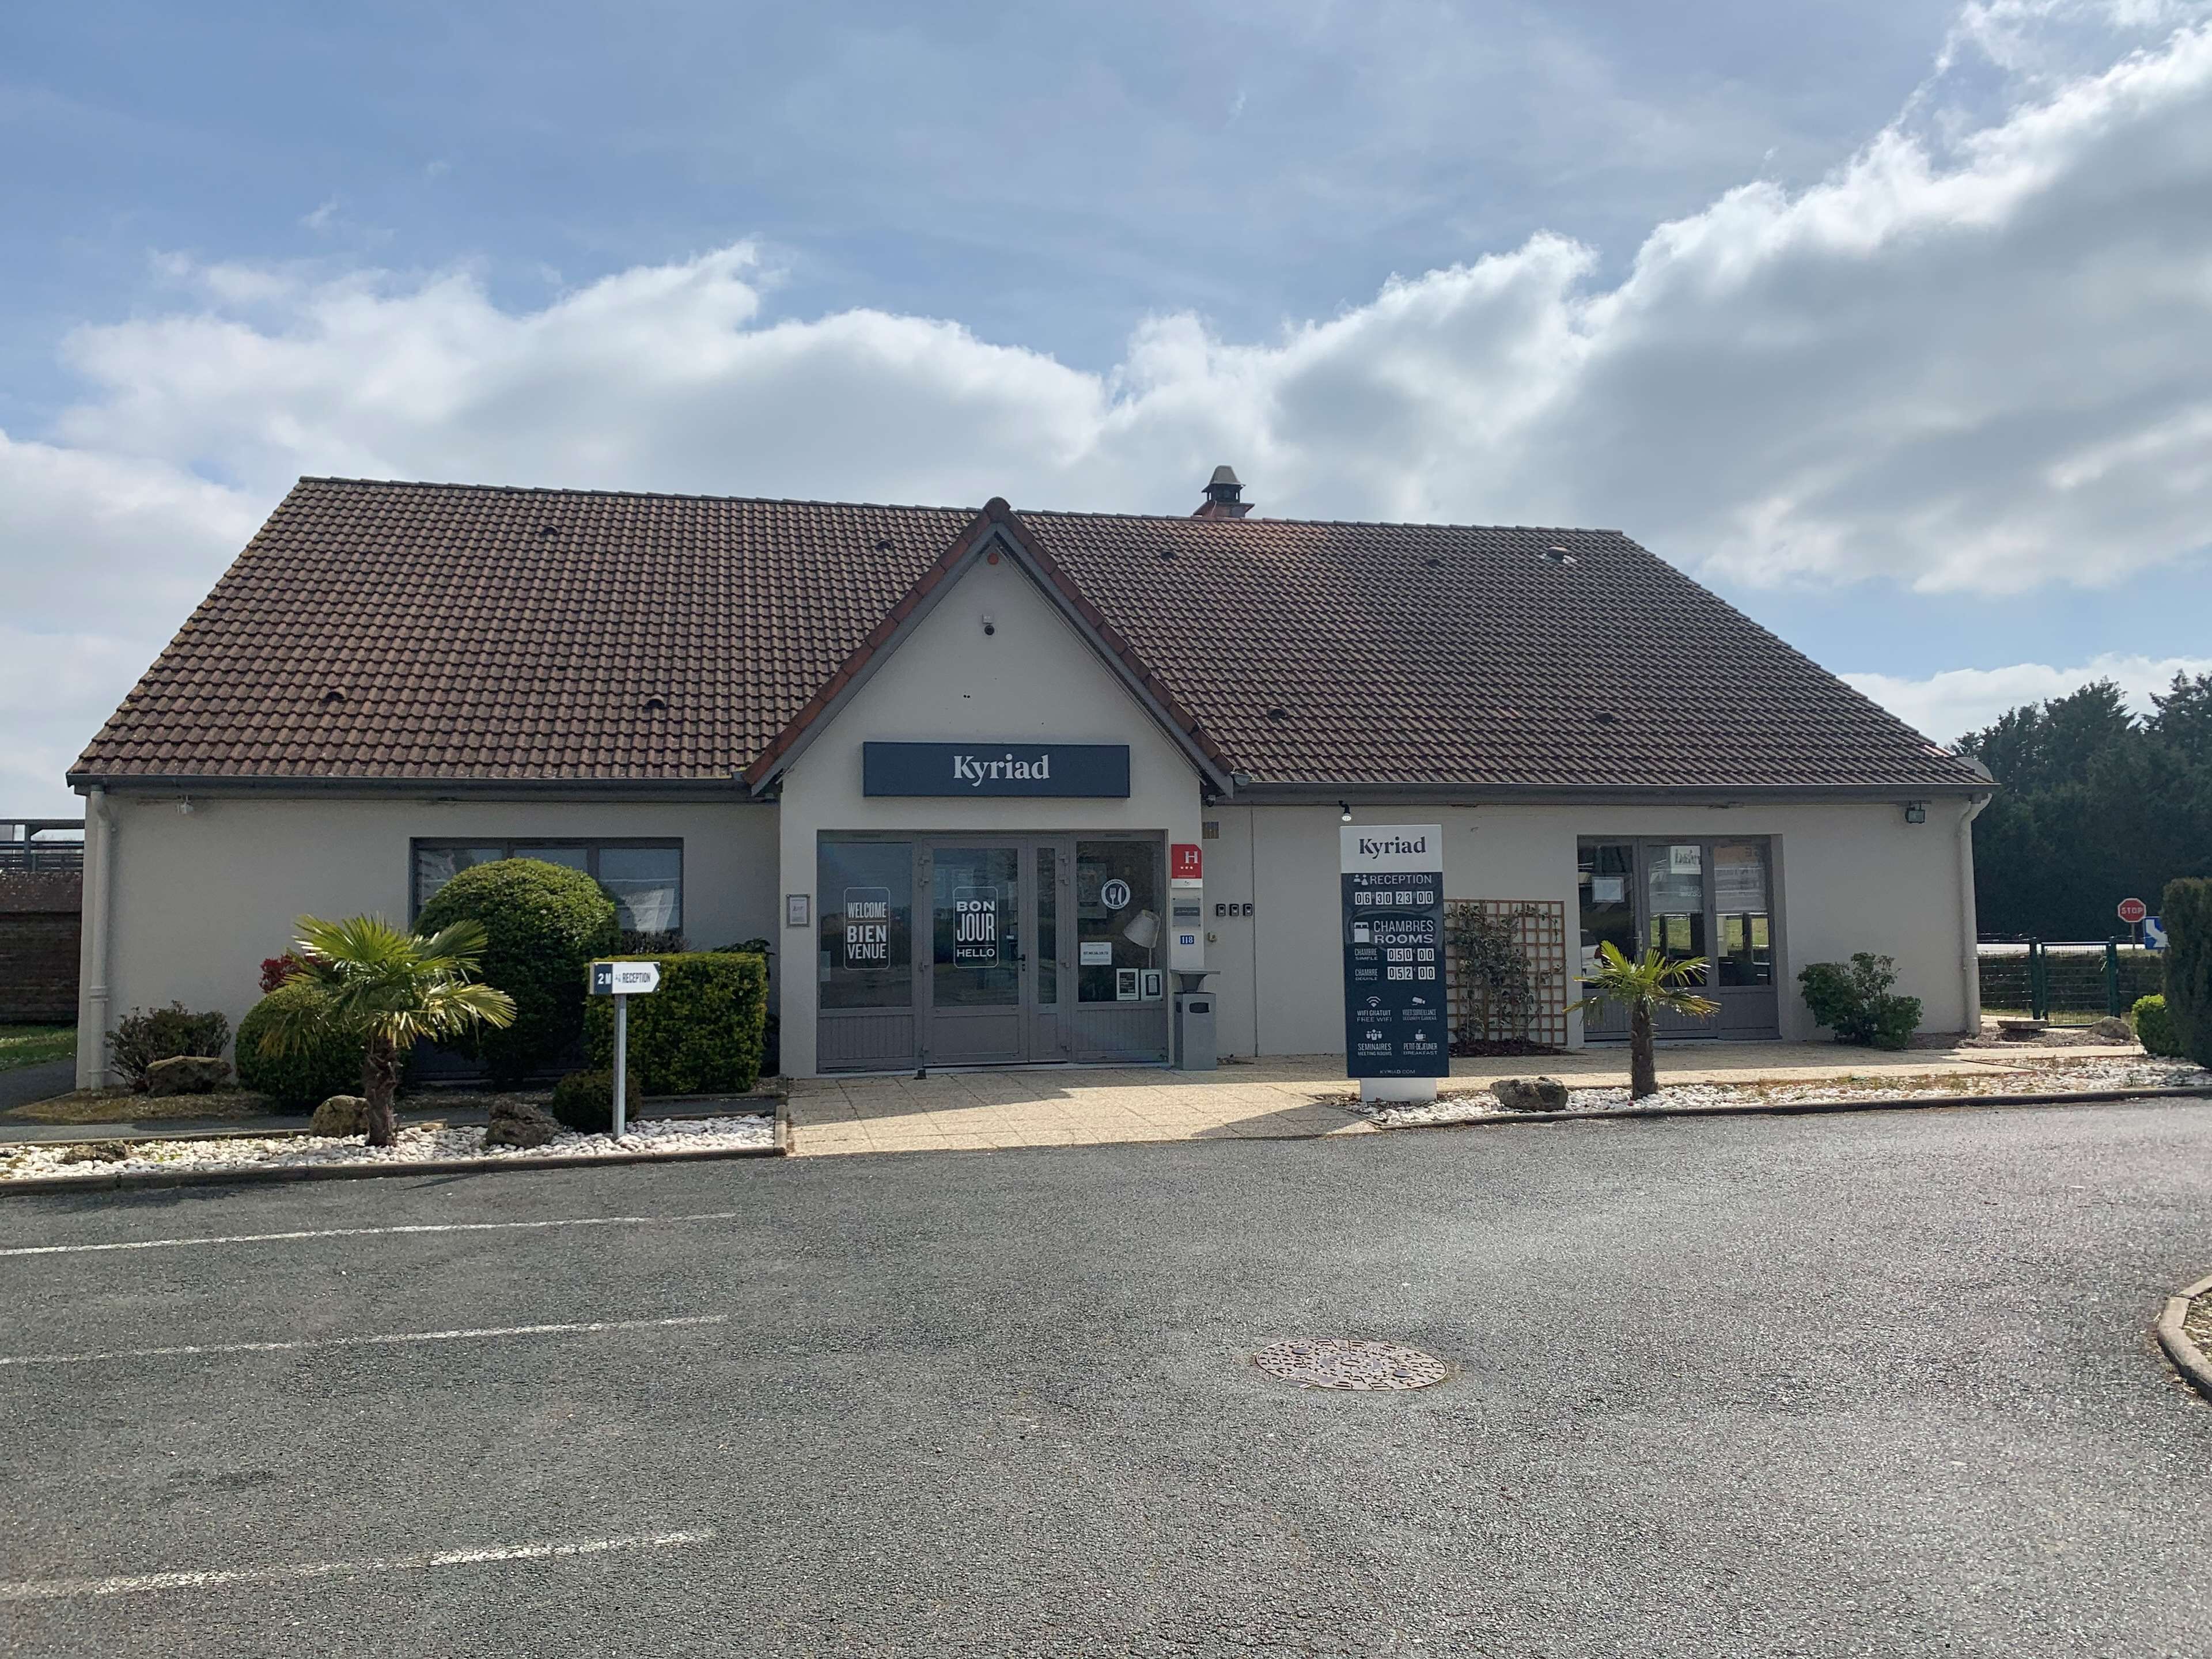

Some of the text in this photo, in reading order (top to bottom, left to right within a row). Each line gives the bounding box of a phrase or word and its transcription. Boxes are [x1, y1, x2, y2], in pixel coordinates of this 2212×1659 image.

[953, 753, 1050, 787] Kyriad
[1359, 836, 1426, 859] Kyriad
[1184, 851, 1198, 863] H
[1370, 874, 1432, 884] RECEPTION
[847, 902, 887, 918] WELCOME
[956, 901, 995, 912] BON
[957, 913, 995, 941] JOUR
[1374, 921, 1434, 932] CHAMBRES
[847, 925, 887, 943] BIEN
[1374, 934, 1434, 944] ROOMS
[847, 944, 887, 959] VENUE
[957, 949, 995, 957] HELLO
[598, 973, 604, 984] 2
[622, 972, 651, 983] RECEPTION
